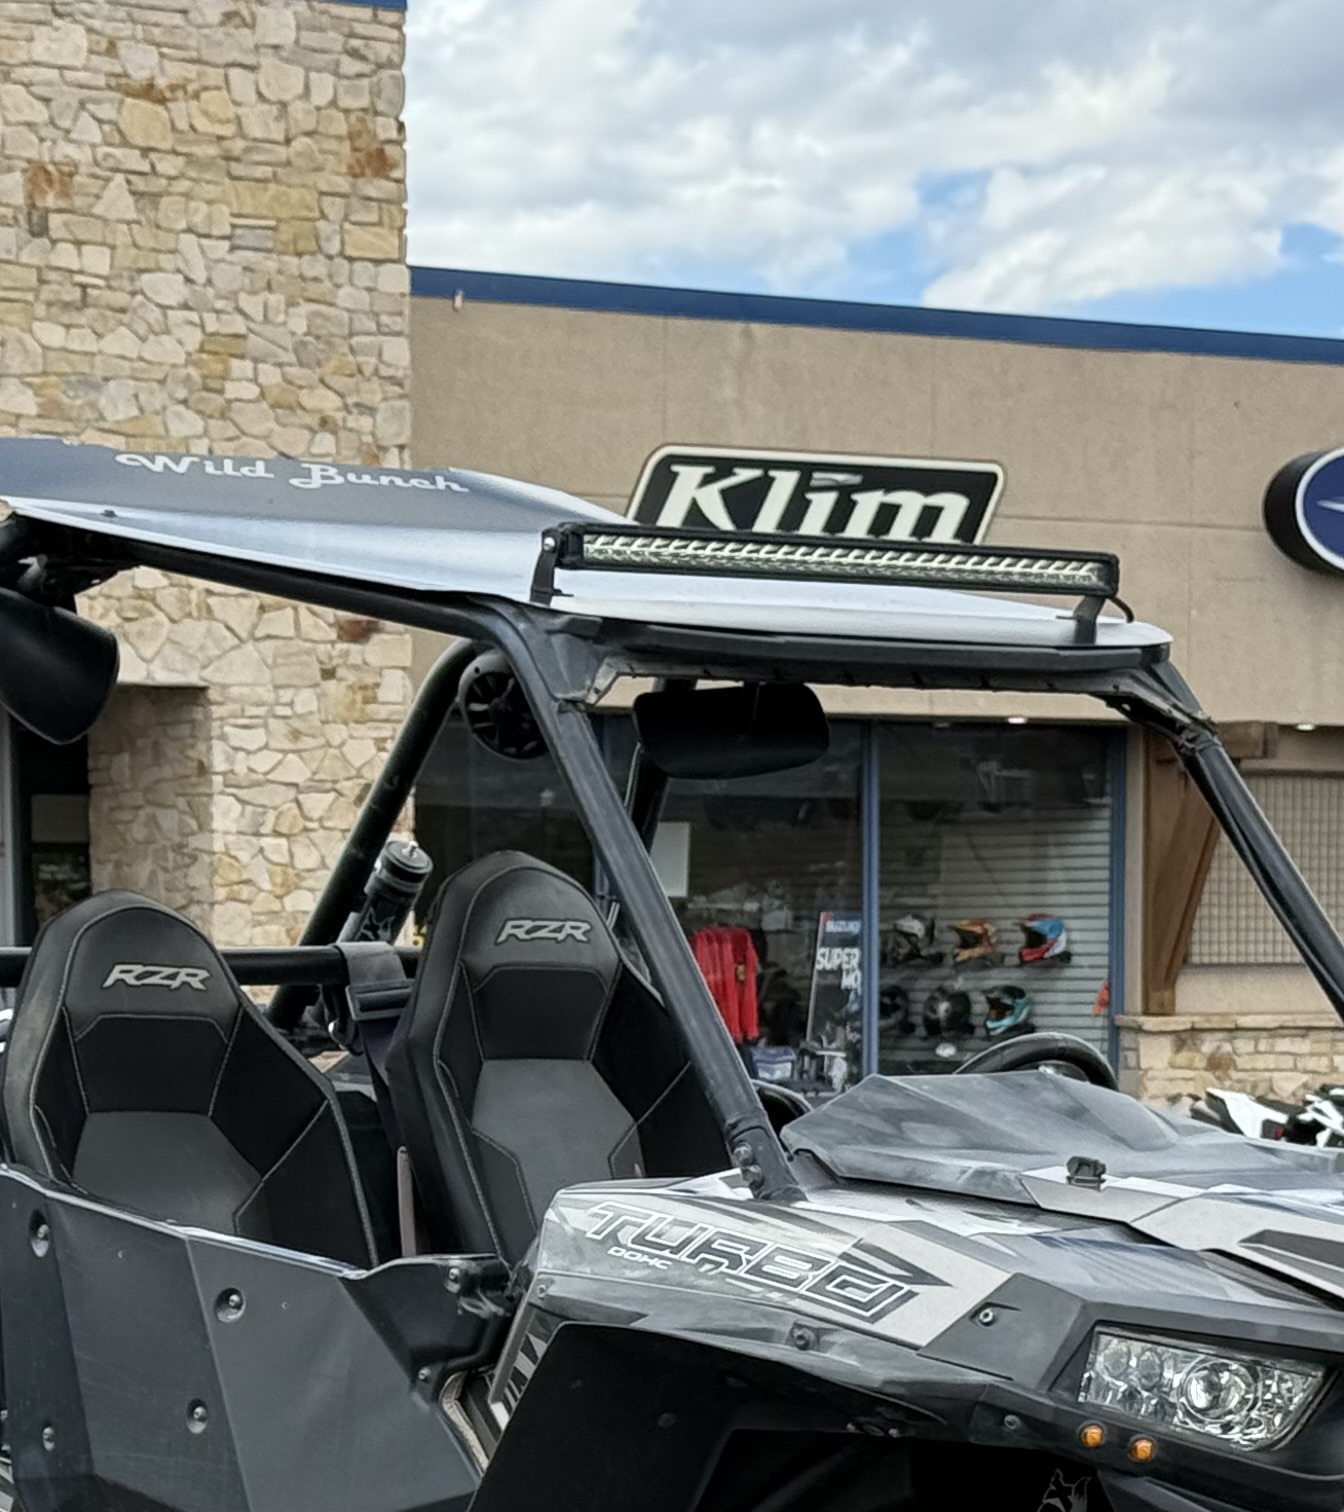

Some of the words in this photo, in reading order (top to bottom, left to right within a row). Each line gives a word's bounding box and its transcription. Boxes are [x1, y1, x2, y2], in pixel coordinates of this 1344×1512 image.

[115, 453, 275, 478] Wild
[288, 463, 469, 493] Bunch
[495, 918, 593, 944] RZR
[815, 947, 861, 971] SUPER
[101, 963, 212, 991] RZR
[584, 1200, 914, 1320] TURBO
